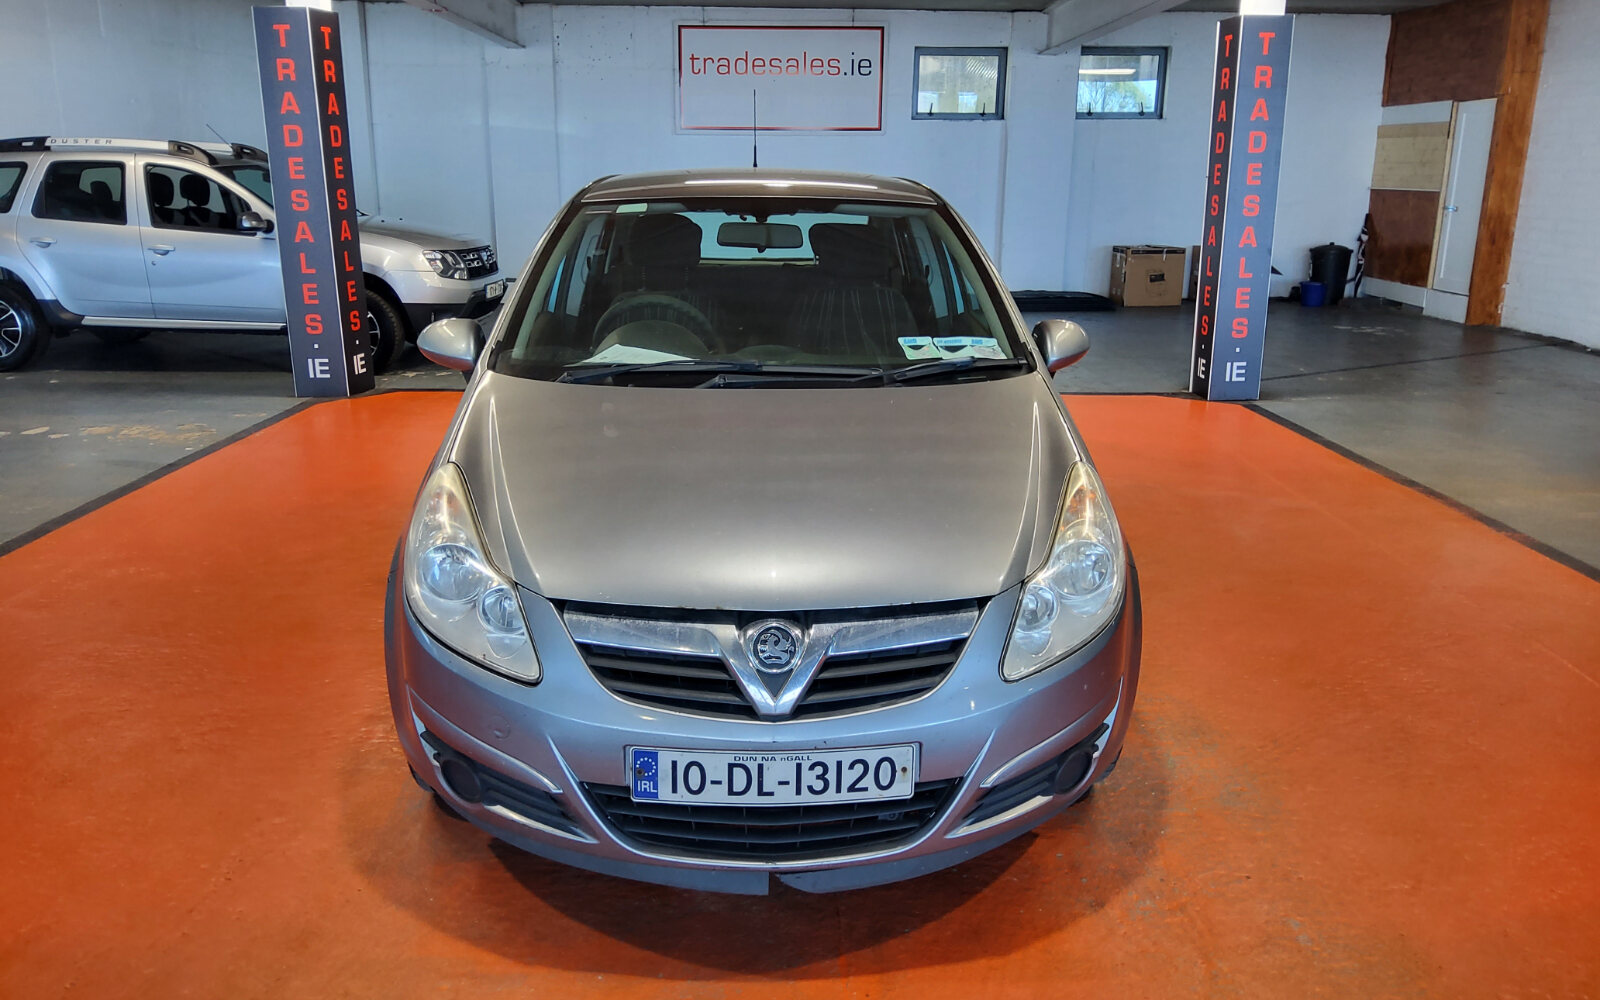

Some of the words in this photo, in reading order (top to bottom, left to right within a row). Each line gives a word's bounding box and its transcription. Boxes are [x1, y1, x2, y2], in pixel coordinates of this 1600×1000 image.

[689, 51, 872, 76] tradesales.ie
[637, 779, 658, 793] IRL
[670, 756, 897, 797] 10-DL-13120
